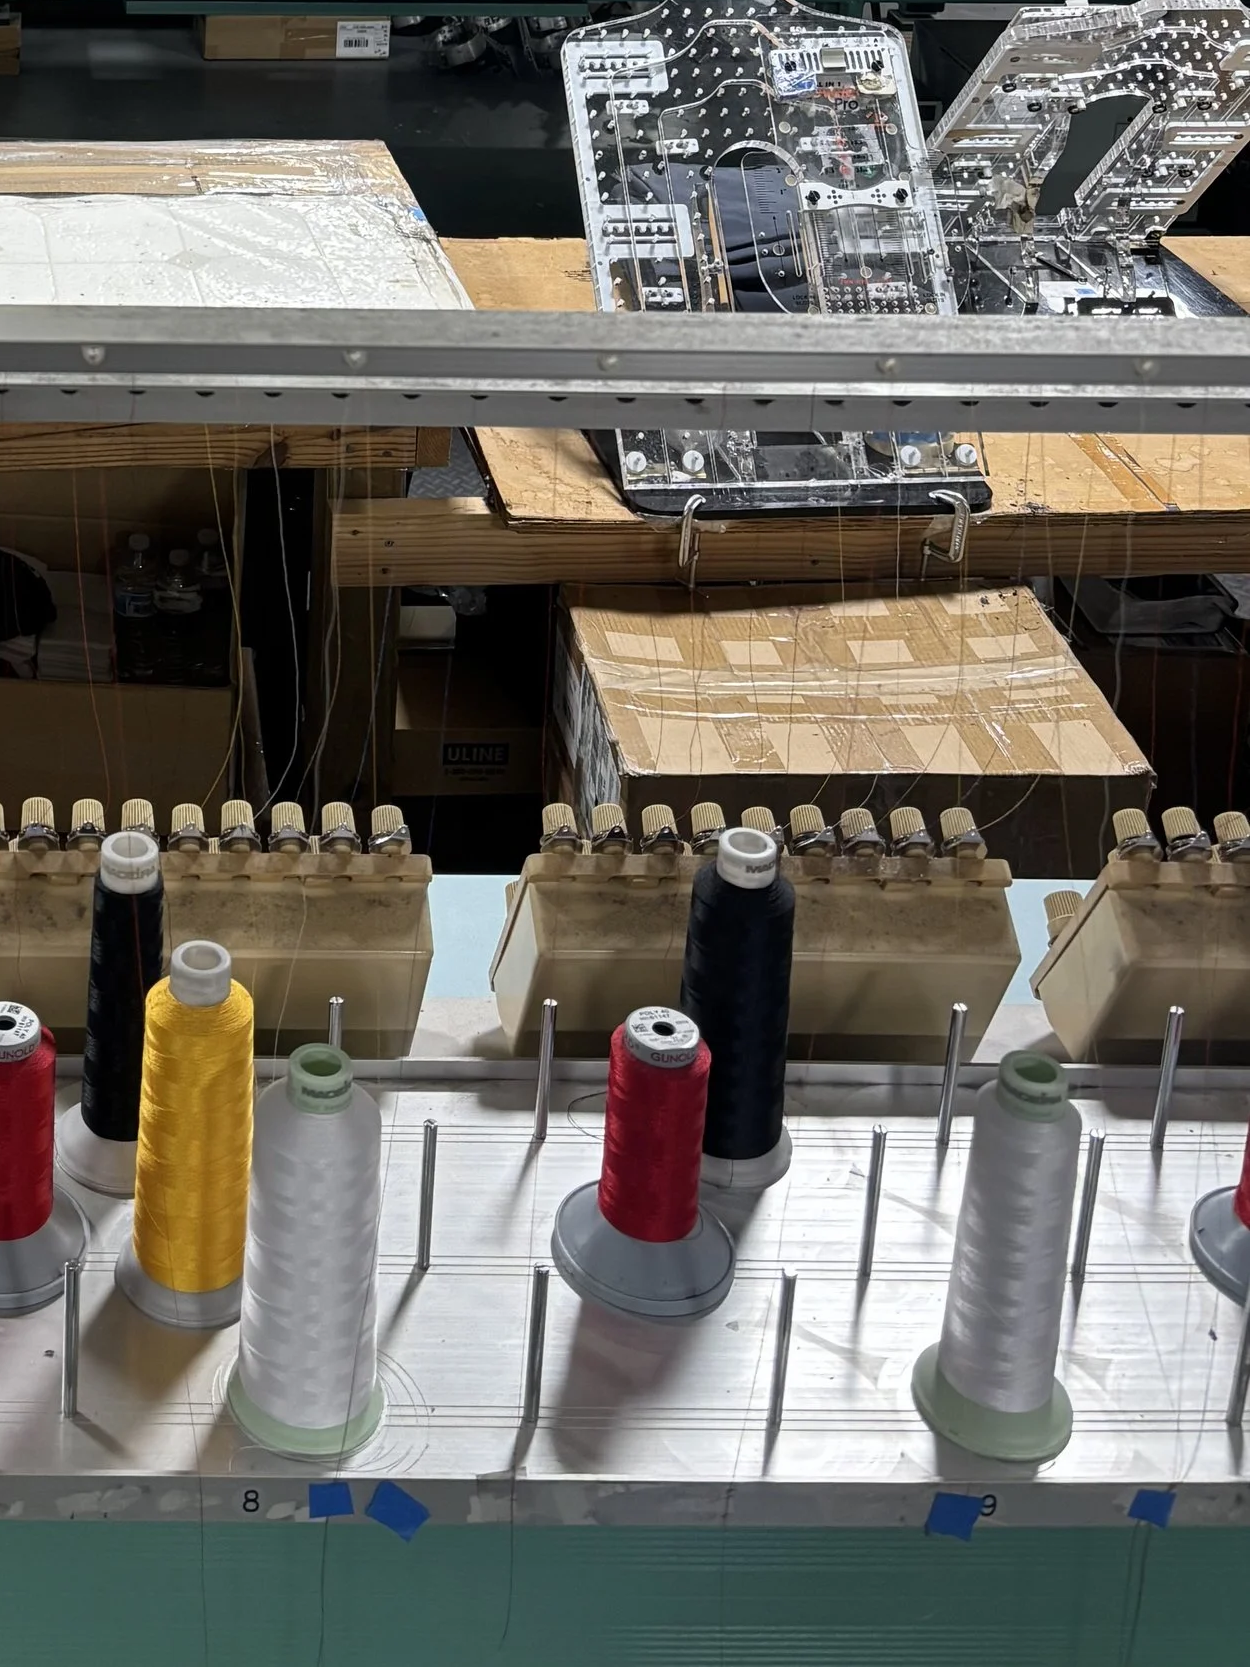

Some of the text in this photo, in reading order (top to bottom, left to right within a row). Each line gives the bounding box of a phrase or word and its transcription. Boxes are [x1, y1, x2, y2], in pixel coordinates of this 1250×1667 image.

[834, 97, 859, 111] Pro
[447, 747, 505, 762] ULINE
[242, 1489, 260, 1513] 8
[980, 1493, 997, 1517] 9
